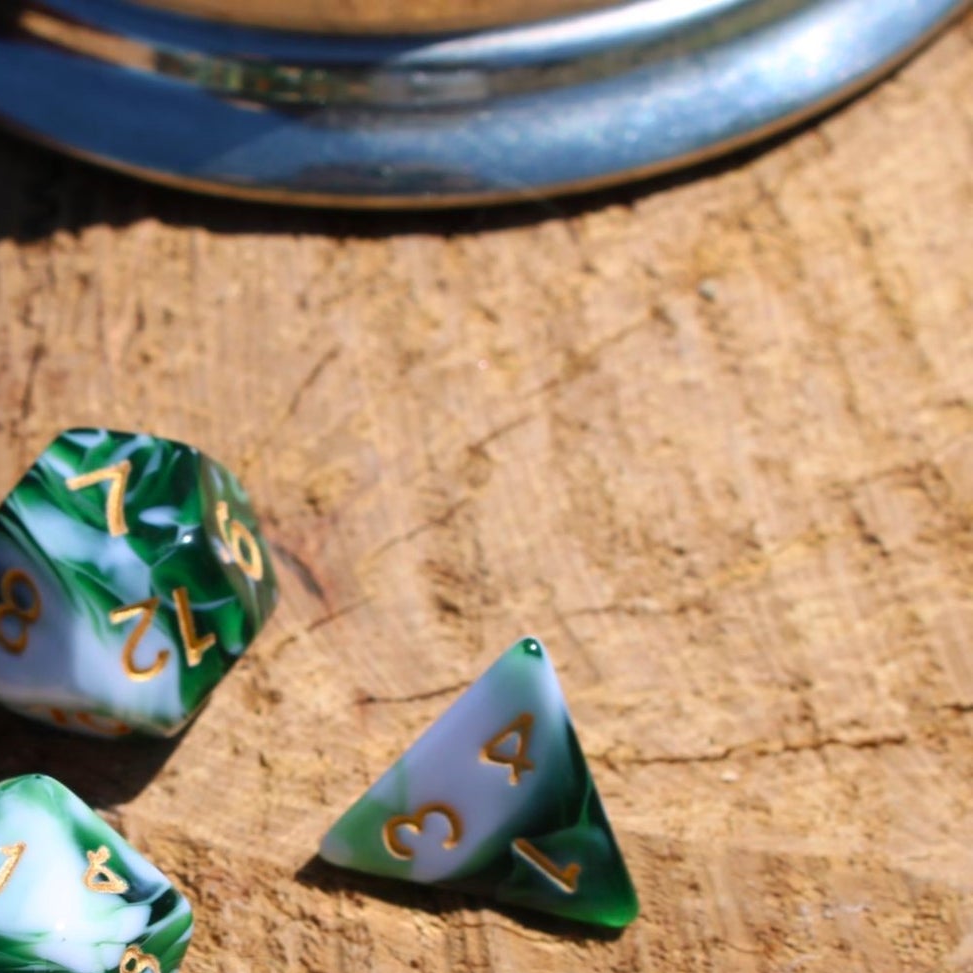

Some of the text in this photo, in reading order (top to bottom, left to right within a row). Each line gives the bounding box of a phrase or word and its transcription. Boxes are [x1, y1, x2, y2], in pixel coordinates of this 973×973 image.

[65, 459, 132, 537] 7
[109, 587, 216, 682] 12
[479, 711, 536, 787] 4
[382, 803, 464, 862] 3
[511, 837, 582, 894] 1
[81, 845, 129, 895] 4
